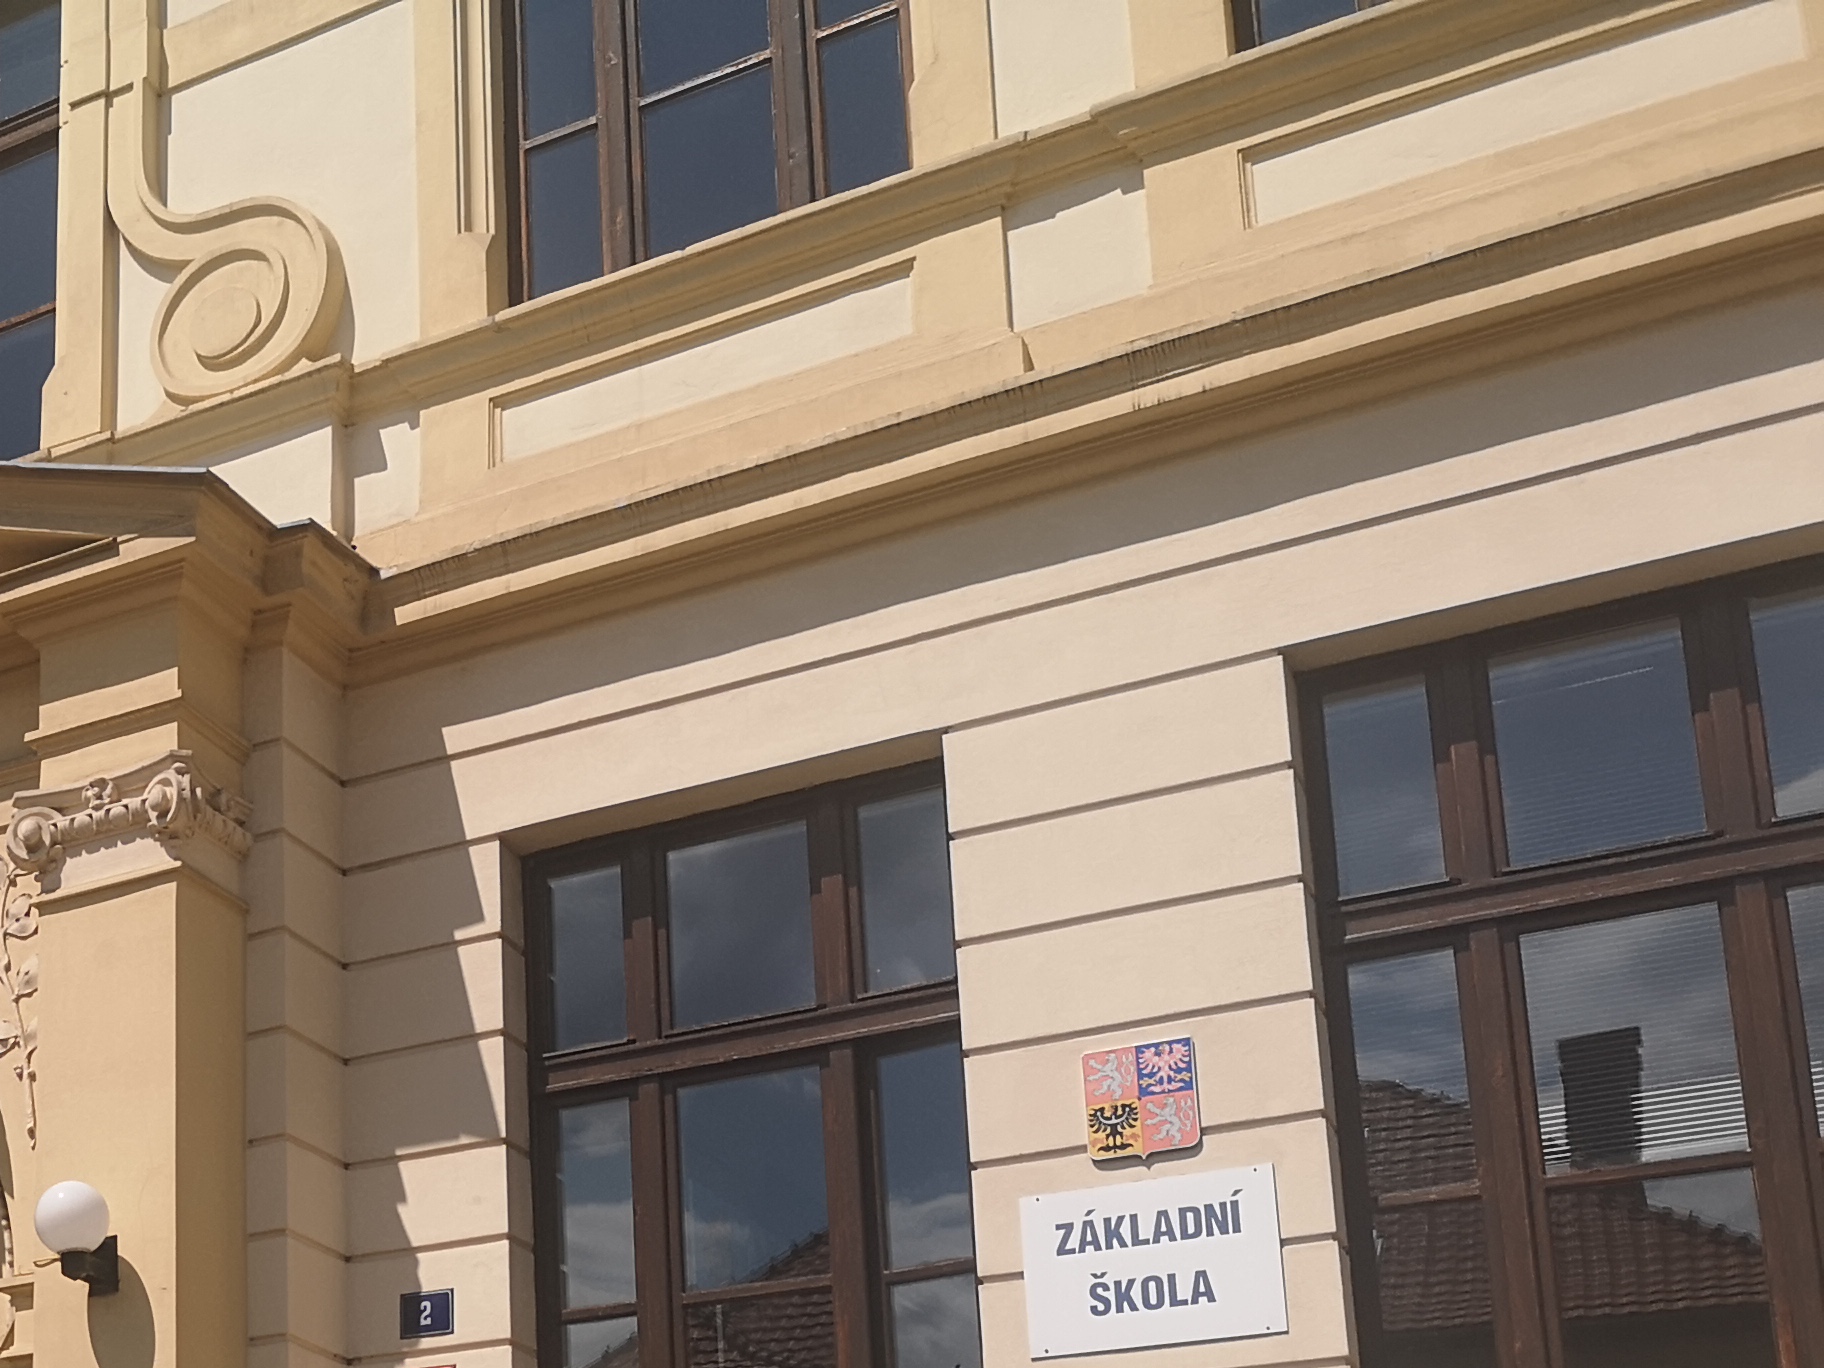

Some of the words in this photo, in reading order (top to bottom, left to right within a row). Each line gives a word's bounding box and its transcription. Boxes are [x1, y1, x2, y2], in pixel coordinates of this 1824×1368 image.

[1054, 1188, 1243, 1257] ZÁKLADNÍ
[419, 1300, 432, 1326] 2
[1088, 1269, 1217, 1317] ŠKOLA
